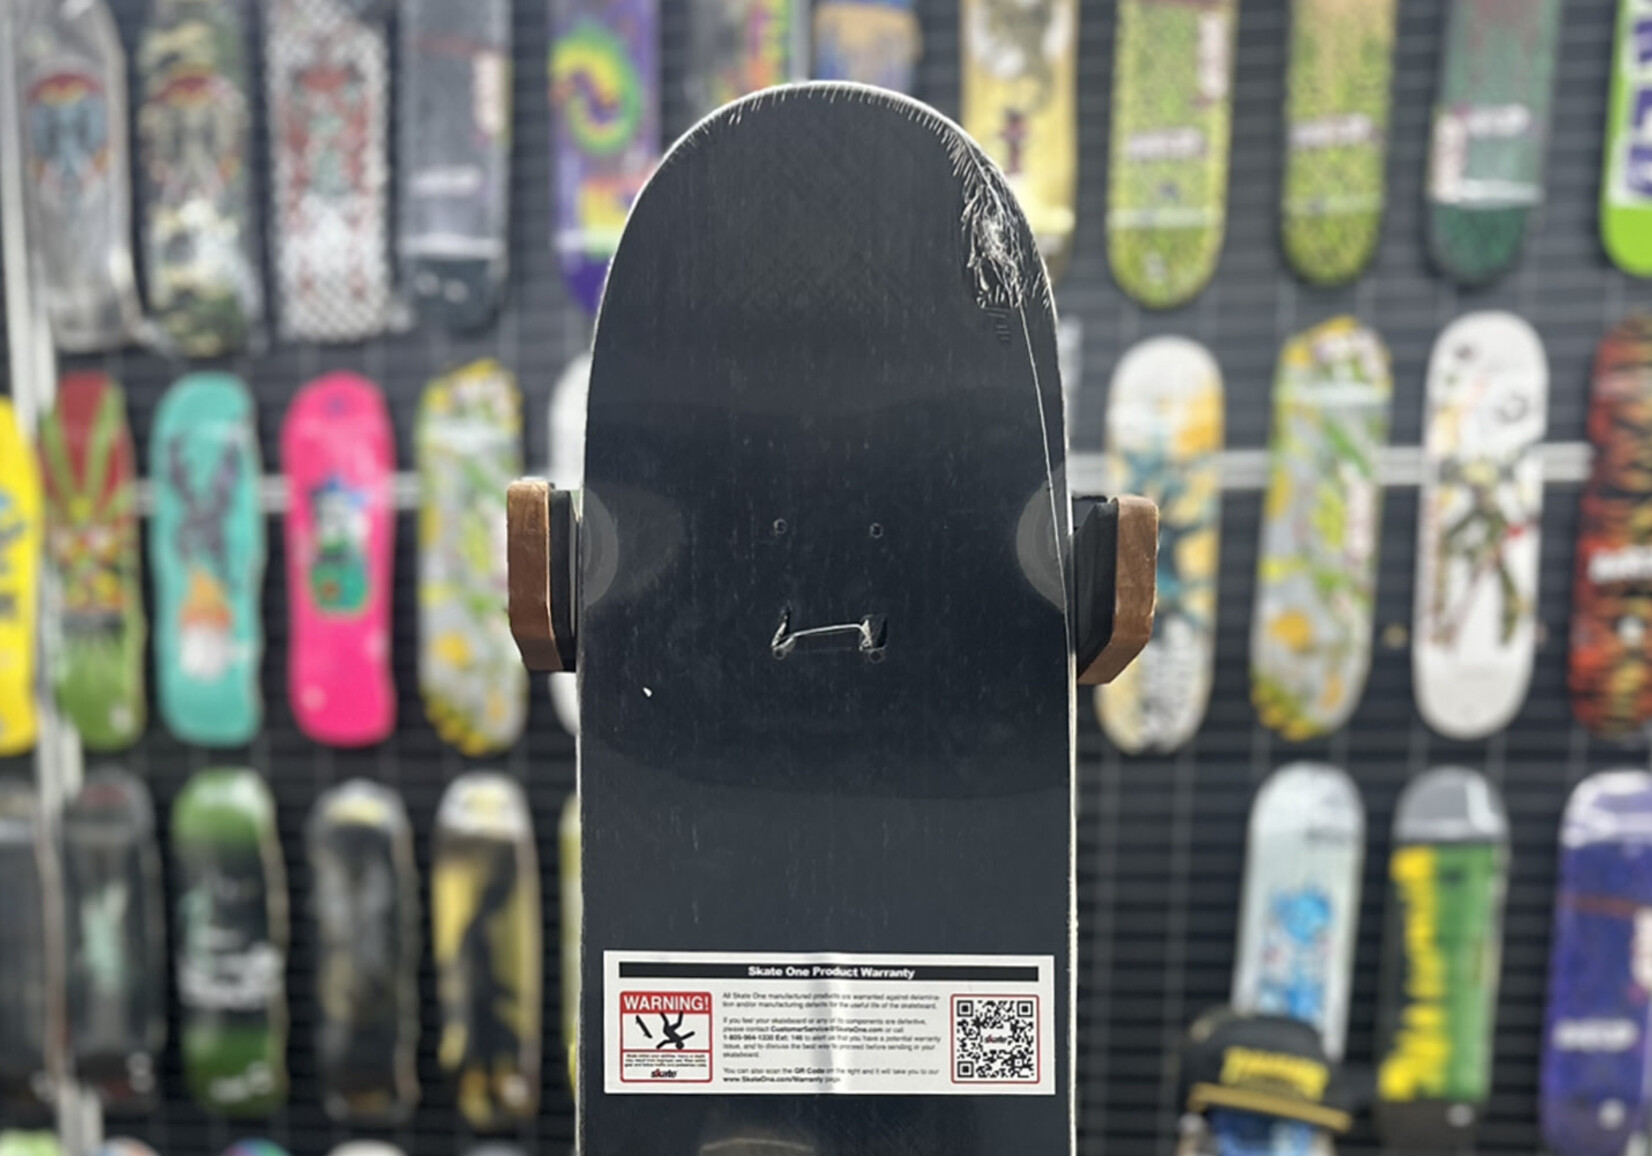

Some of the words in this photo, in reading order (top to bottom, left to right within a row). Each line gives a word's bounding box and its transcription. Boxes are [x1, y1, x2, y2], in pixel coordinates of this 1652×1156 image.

[748, 966, 783, 977] Skate
[785, 966, 810, 977] One
[813, 966, 859, 978] Product
[860, 967, 916, 980] Warranty
[623, 995, 710, 1011] WARNING!
